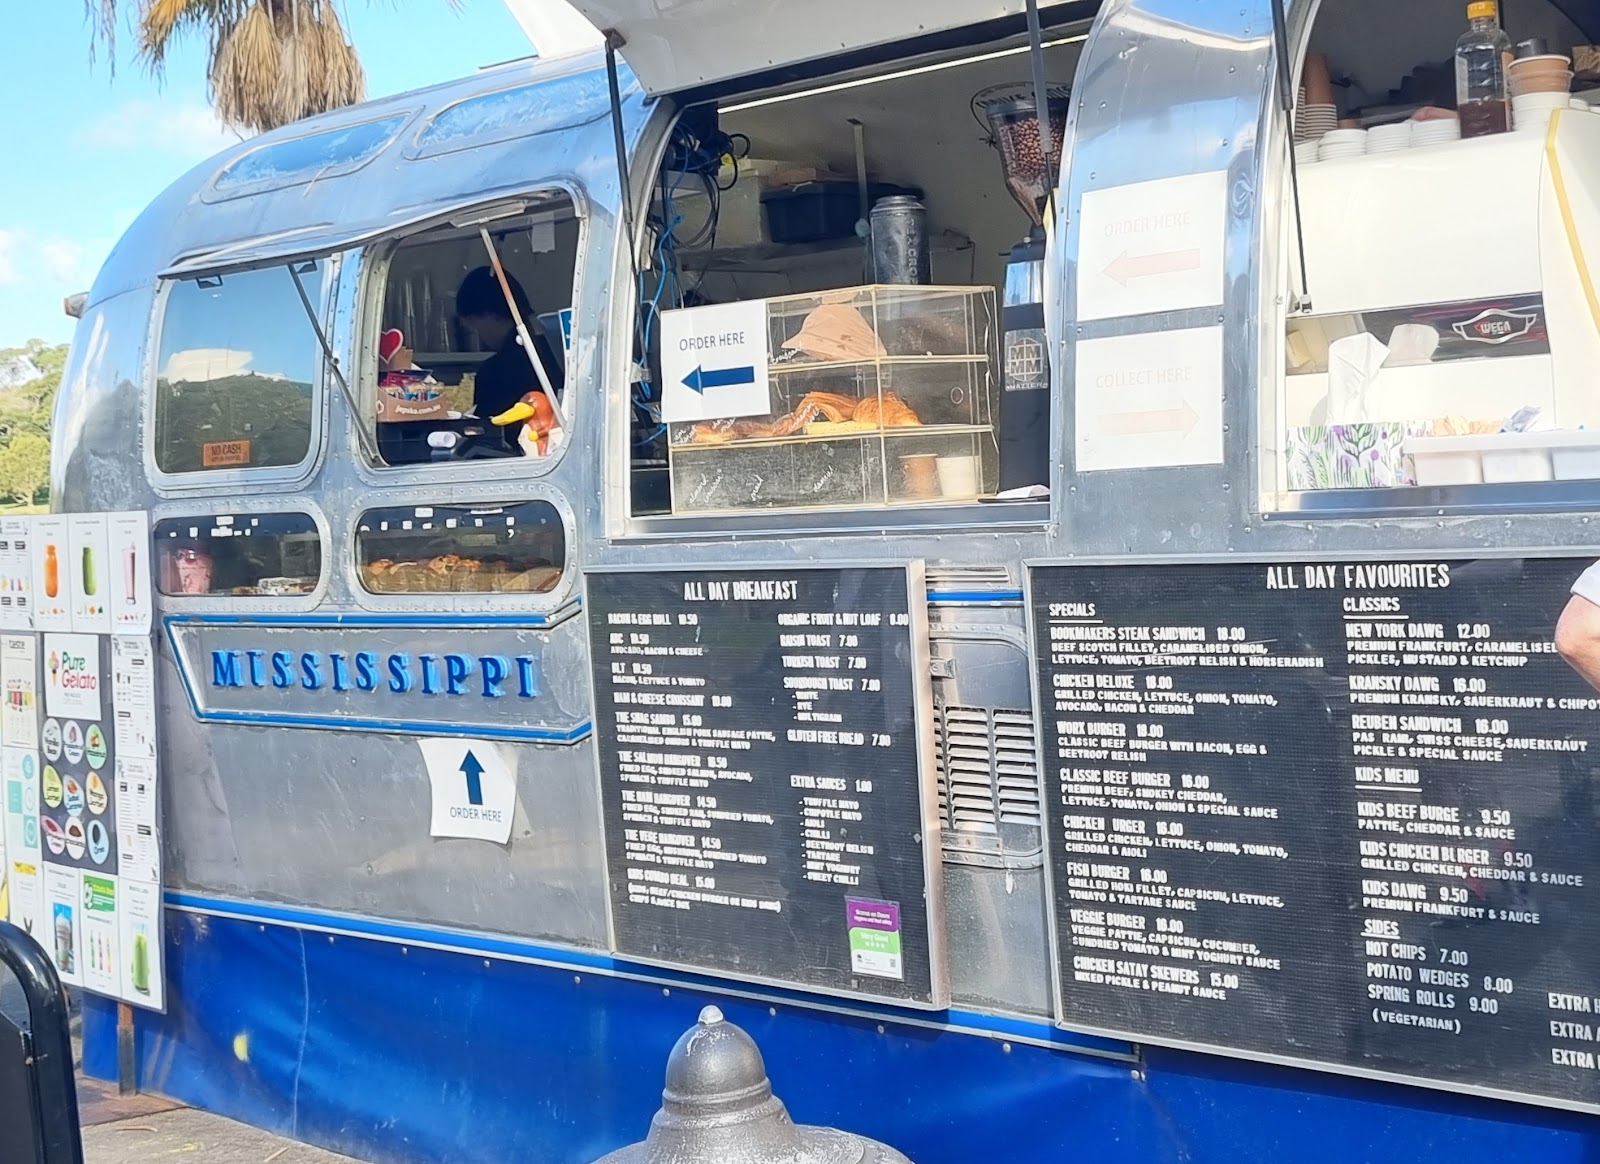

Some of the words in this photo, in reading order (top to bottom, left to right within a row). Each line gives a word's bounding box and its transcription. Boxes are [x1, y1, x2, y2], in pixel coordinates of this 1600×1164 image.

[1104, 215, 1149, 238] ORDER
[1152, 210, 1191, 230] HERE
[1480, 321, 1511, 334] WEGA
[679, 338, 716, 352] ORDER
[719, 331, 745, 346] HERE
[1096, 370, 1152, 388] COLLECT
[1156, 367, 1192, 384] HERE
[1266, 566, 1298, 589] ALL
[1305, 565, 1336, 588] DAY
[1344, 564, 1449, 588] FAVOURITES
[684, 582, 705, 600] ALL
[708, 582, 729, 600] DAY
[733, 581, 797, 600] BREAKFAST
[1049, 604, 1095, 616] SPECIALS
[1343, 597, 1400, 612] CLASSICS
[806, 635, 830, 646] TOAST
[839, 635, 858, 647] 7.00
[1051, 627, 1115, 640] BOOKMAKERS
[1118, 627, 1150, 641] STEAK
[1153, 627, 1205, 641] SANDWICH
[1346, 623, 1372, 637] NEW
[1375, 623, 1406, 638] YORK
[1409, 624, 1444, 638] DAWG
[1457, 623, 1490, 639] 12.00
[1347, 641, 1396, 651] PREMIUM
[1399, 642, 1473, 653] FRANKFURT,
[61, 651, 85, 671] Pure
[815, 656, 839, 668] TOAST
[848, 657, 866, 669] 7.00
[1348, 654, 1400, 666] PICKLES,
[1403, 655, 1457, 665] MUSTARD
[1460, 656, 1466, 665] &
[1472, 656, 1528, 667] KETCHUP
[62, 669, 96, 690] Gelato
[212, 650, 542, 697] MISSISSIPPI
[1053, 674, 1094, 687] CHICKEN
[1096, 675, 1134, 688] DELUXE
[829, 678, 853, 690] TOAST
[862, 679, 880, 691] 7.00
[1349, 676, 1401, 691] KRANSKY
[1404, 677, 1439, 692] DAWG
[1453, 678, 1486, 693] 16.00
[1350, 693, 1399, 704] PREMIUM
[1402, 694, 1462, 707] KRANSKY,
[1464, 696, 1543, 708] SAUERKRAUT
[1547, 699, 1556, 708] &
[1057, 721, 1085, 734] WORX
[1088, 722, 1125, 736] BURGER
[1352, 715, 1397, 730] REUBEN
[1400, 716, 1461, 733] SANDWICH
[1475, 719, 1509, 735] 16.00
[818, 731, 838, 743] FREE
[872, 734, 891, 746] 7.00
[1417, 735, 1450, 746] SWISS
[1353, 745, 1394, 756] PICKLE
[1398, 747, 1406, 757] &
[1409, 748, 1459, 760] SPECIAL
[1463, 750, 1503, 762] SAUCE
[1060, 768, 1100, 782] CLASSIC
[1103, 770, 1129, 784] BEEF
[1131, 772, 1170, 787] BURGER
[1181, 774, 1209, 789] 16.00
[1355, 767, 1382, 782] KIDS
[1385, 768, 1419, 784] MENU
[450, 806, 479, 821] ORDER
[481, 808, 502, 822] HERE
[1357, 802, 1384, 817] KIDS
[1387, 803, 1417, 819] BEEF
[1481, 809, 1510, 825] 9.50
[1063, 815, 1104, 830] CHICKEN
[1156, 821, 1183, 836] 16.00
[1358, 819, 1404, 834] PATTIE,
[1406, 822, 1460, 835] CHEDDAR
[1464, 826, 1472, 836] &
[1475, 827, 1515, 840] SAUCE
[1360, 841, 1387, 856] KIDS
[1389, 843, 1439, 861] CHICKEN
[1504, 851, 1532, 867] 9.50
[1067, 862, 1089, 877] FISH
[1092, 864, 1130, 880] BURGER
[1140, 867, 1167, 883] 16.00
[1361, 856, 1409, 871] GRILLED
[1413, 863, 1467, 879] CHICKEN,
[1470, 867, 1525, 882] CHEDDAR
[1530, 872, 1537, 882] &
[1542, 873, 1583, 886] SAUCE
[1362, 880, 1389, 896] KIDS
[1392, 882, 1426, 899] DAWG
[1440, 887, 1468, 903] 9.50
[1363, 897, 1413, 911] PREMIUM
[1415, 902, 1484, 918] FRANKFURT
[1489, 910, 1496, 919] &
[1500, 910, 1540, 924] SAUCE
[1070, 909, 1105, 925] VEGGIE
[1107, 912, 1145, 929] BURGER
[1156, 917, 1184, 933] 16.00
[1364, 919, 1399, 935] SIDES
[1366, 940, 1389, 958] HOT
[1392, 943, 1426, 961] CHIPS
[1440, 948, 1468, 966] 7.00
[1074, 956, 1115, 973] CHICKEN
[1117, 960, 1148, 977] SATAY
[1151, 965, 1199, 984] SKEWERS
[1210, 972, 1238, 989] 15.00
[1367, 962, 1412, 981] POTATO
[1419, 968, 1469, 988] WEDGES
[1484, 976, 1513, 993] 8.00
[1368, 984, 1410, 1003] SPRING
[1417, 990, 1455, 1008] ROLLS
[1469, 997, 1498, 1014] 9.00
[1548, 992, 1591, 1012] EXTRA
[1550, 1021, 1593, 1041] EXTRA
[1552, 1048, 1595, 1069] EXTRA
